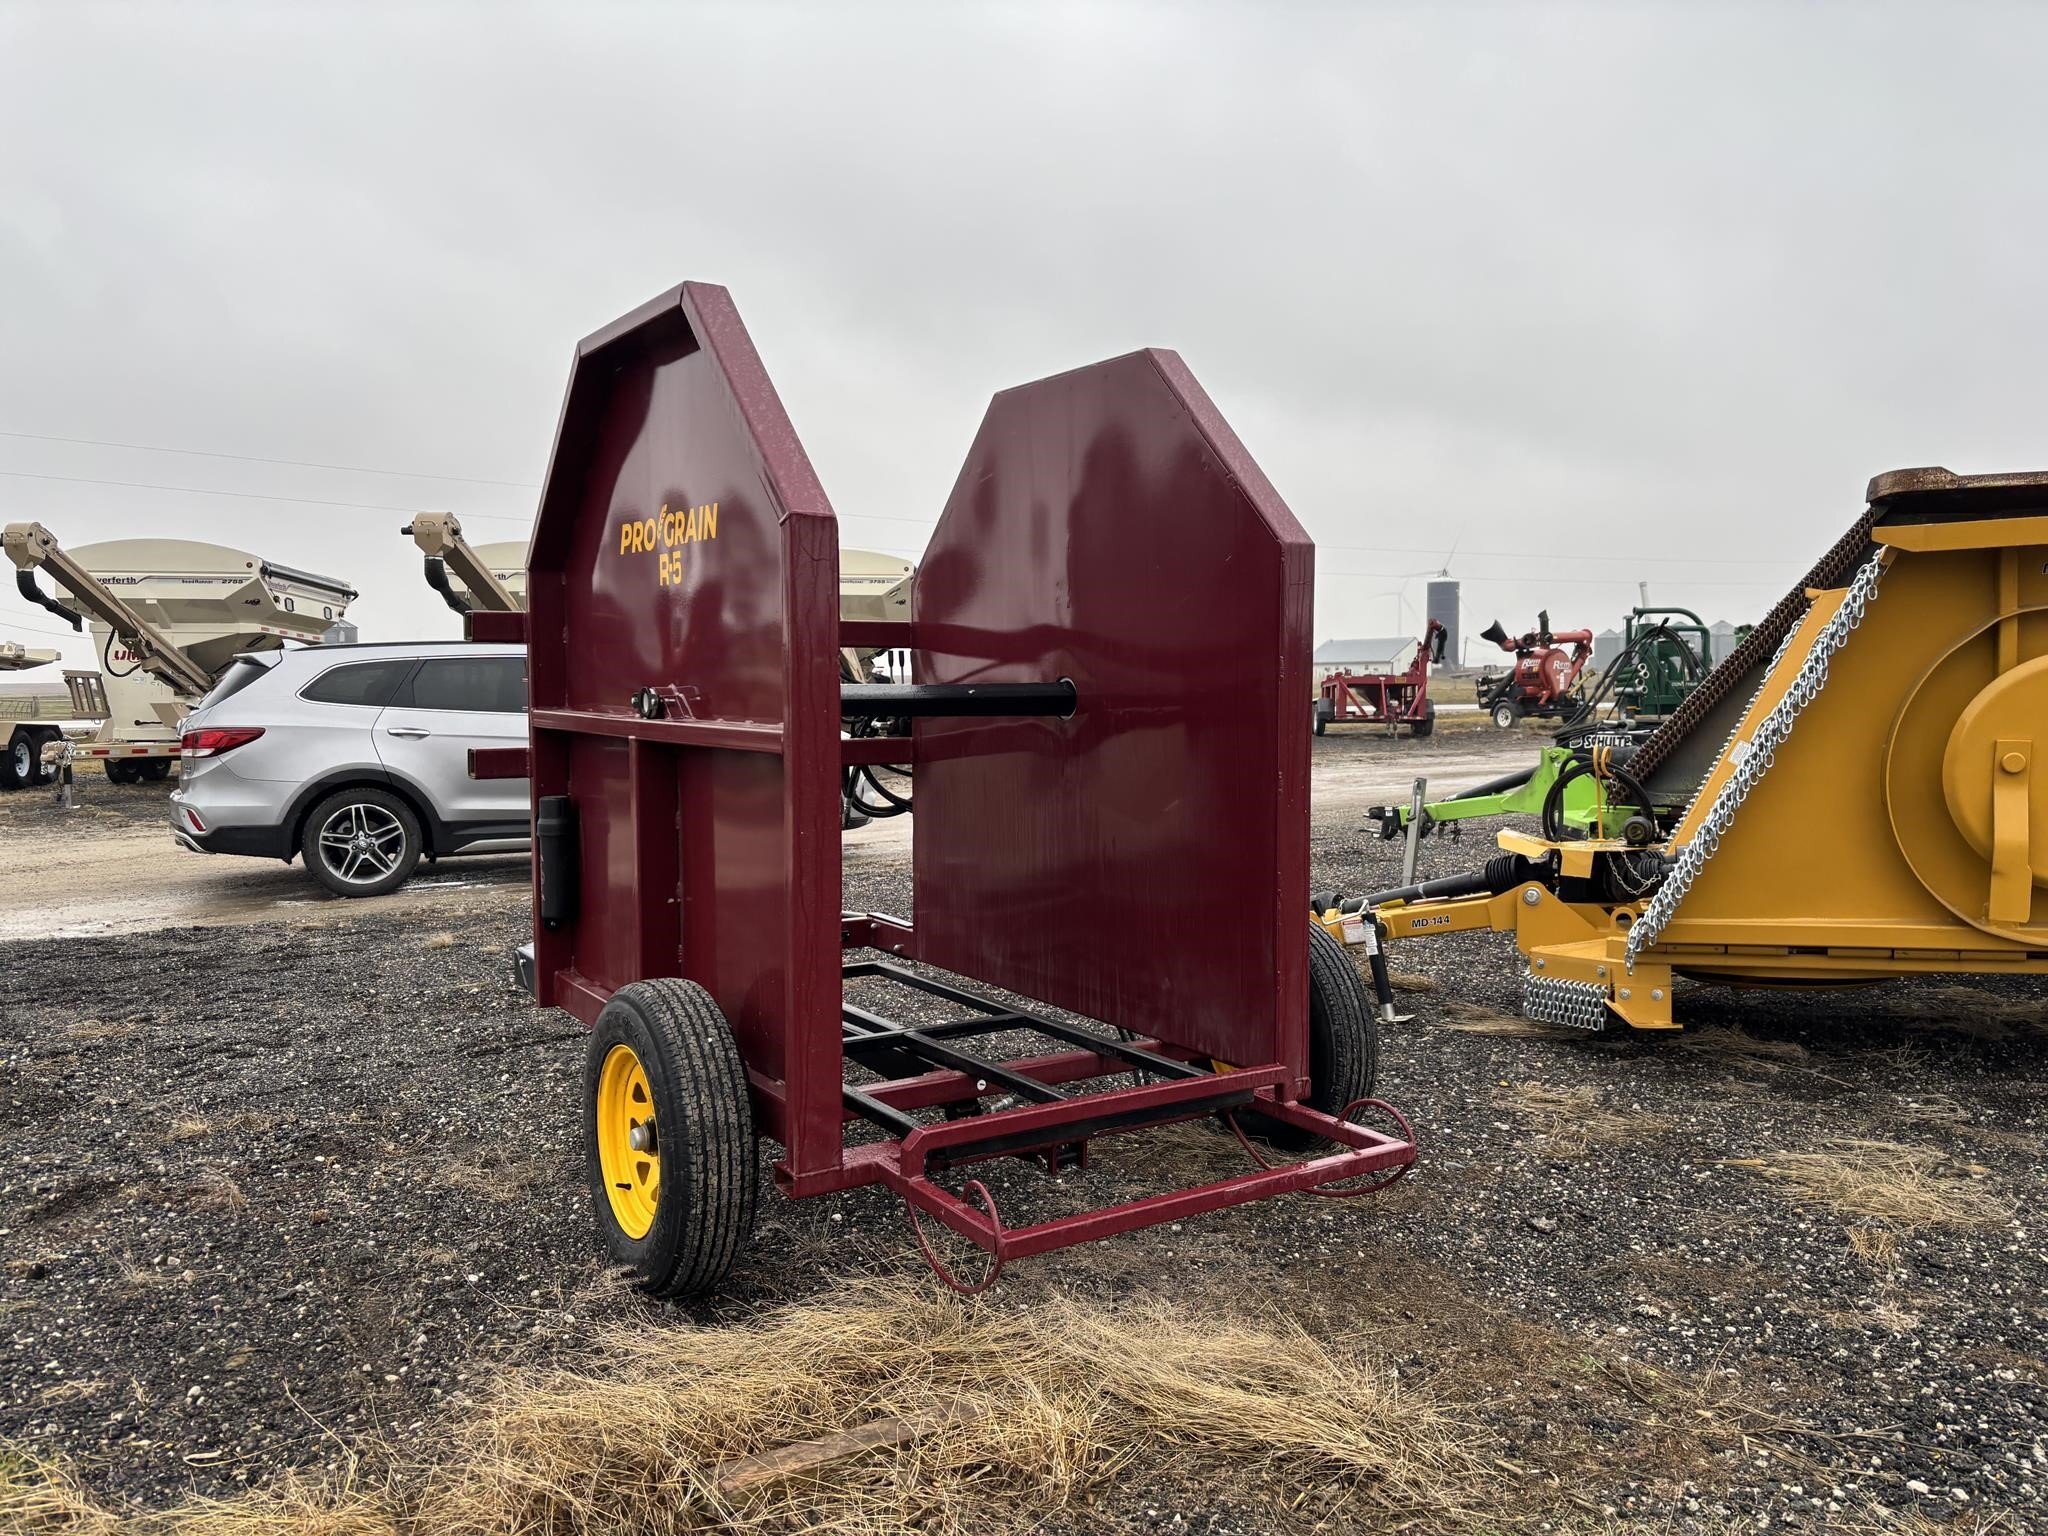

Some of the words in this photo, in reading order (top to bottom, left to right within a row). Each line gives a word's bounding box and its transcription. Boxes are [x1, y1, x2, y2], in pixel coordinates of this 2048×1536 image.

[620, 519, 657, 555] PRO
[663, 503, 719, 548] GRAIN
[96, 576, 137, 585] verferth
[659, 551, 682, 586] R-5
